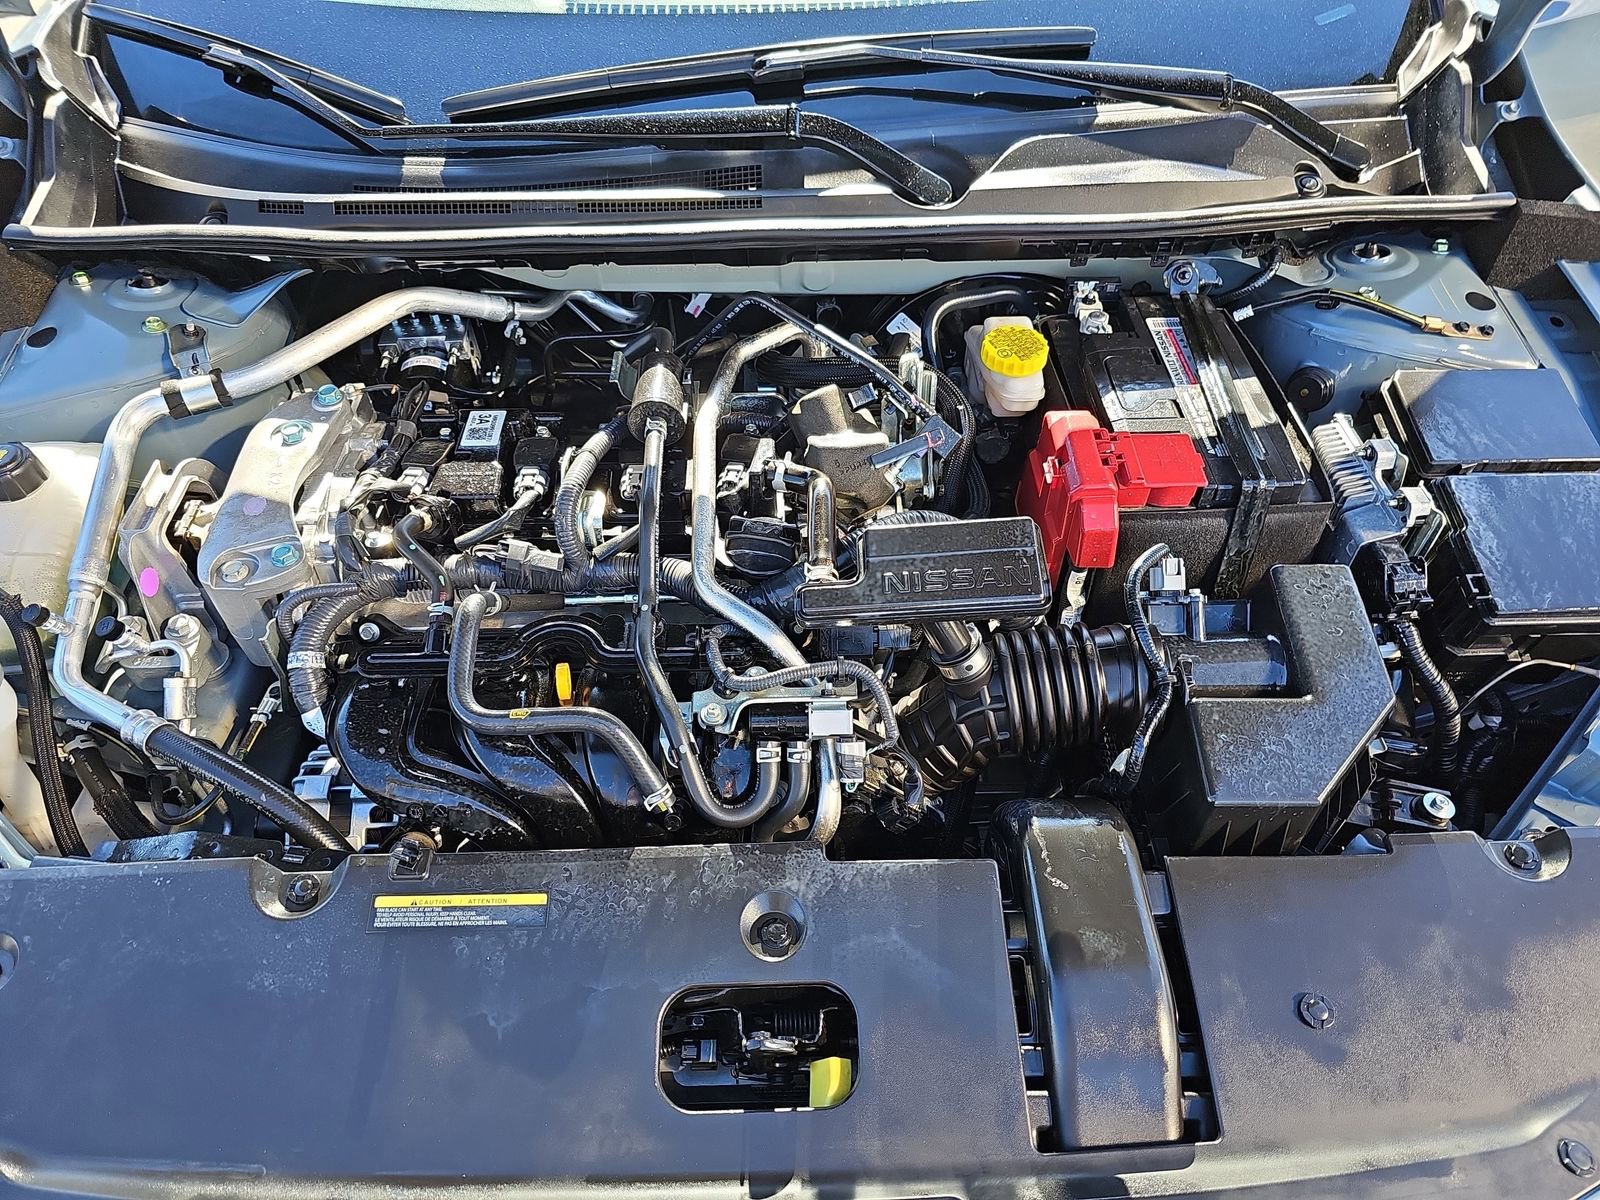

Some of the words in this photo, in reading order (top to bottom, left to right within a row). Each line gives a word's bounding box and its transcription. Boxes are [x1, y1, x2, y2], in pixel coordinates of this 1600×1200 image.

[1154, 330, 1173, 358] NISSAN
[1167, 360, 1186, 385] RENAULT
[476, 414, 492, 425] 3A
[883, 565, 1033, 595] NISSAN
